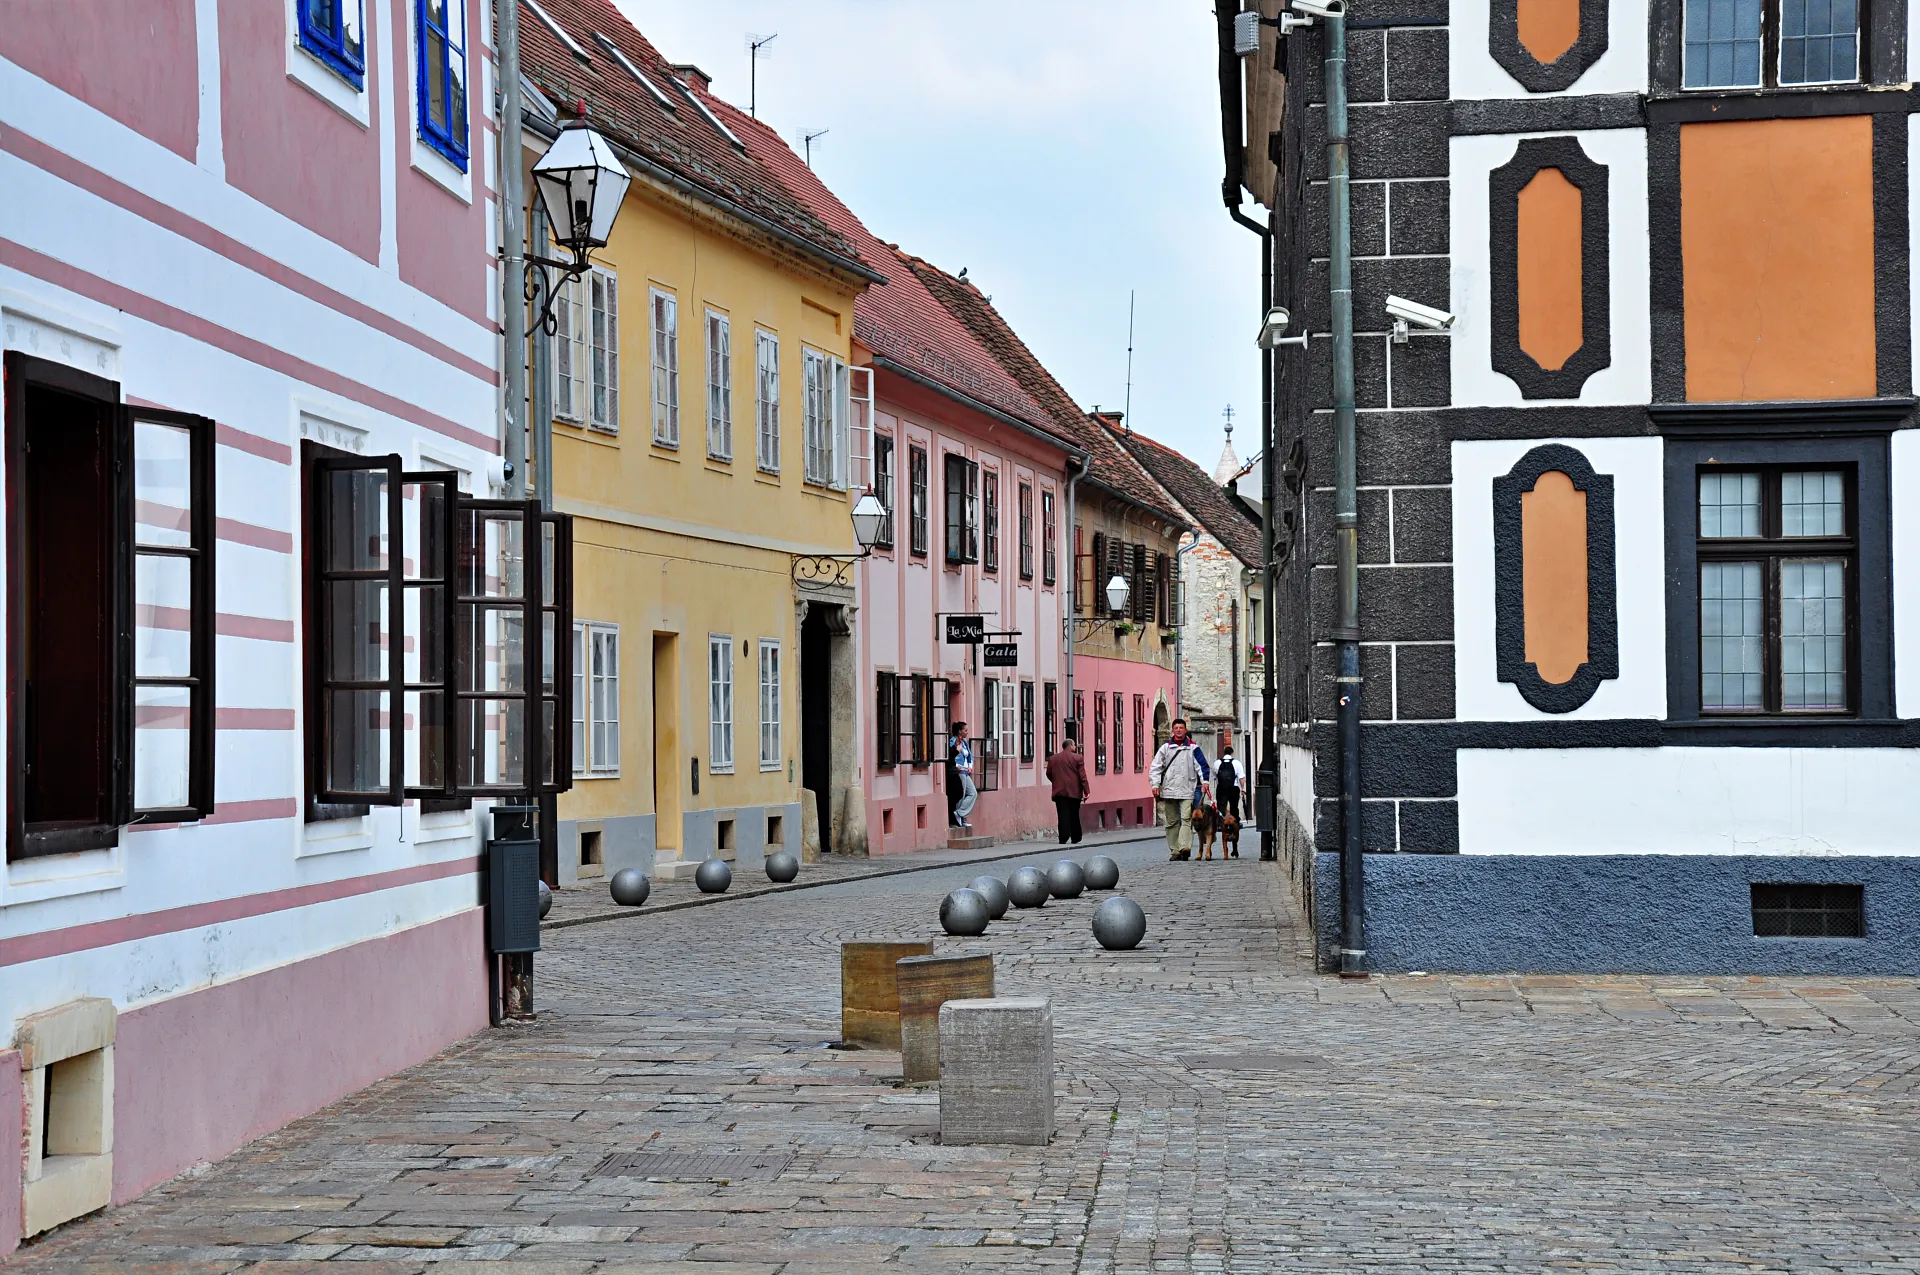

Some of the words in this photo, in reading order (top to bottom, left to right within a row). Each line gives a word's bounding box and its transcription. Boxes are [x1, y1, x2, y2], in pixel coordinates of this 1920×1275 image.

[947, 626, 961, 638] La
[962, 626, 982, 637] Mia
[985, 646, 1017, 656] Gala
